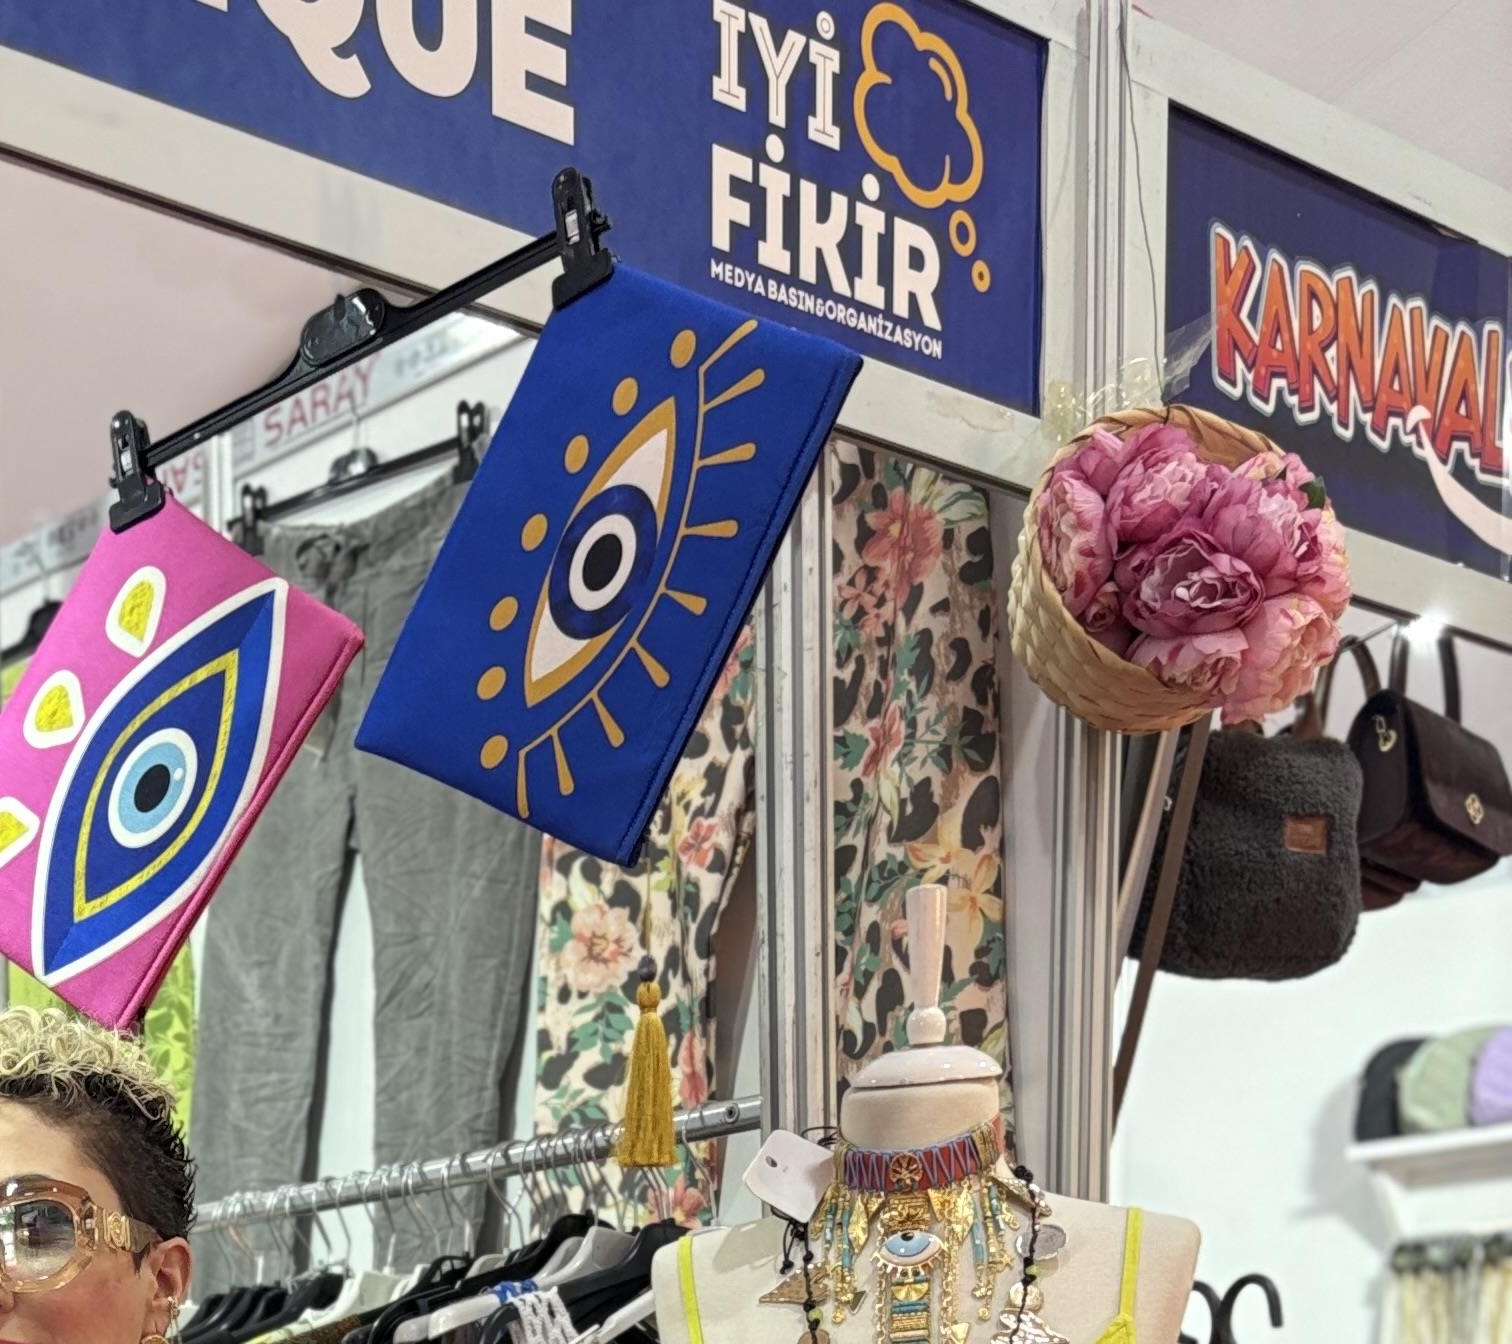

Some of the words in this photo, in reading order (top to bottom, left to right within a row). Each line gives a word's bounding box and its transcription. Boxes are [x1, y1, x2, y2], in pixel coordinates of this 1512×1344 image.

[200, 0, 575, 146] QUE
[710, 257, 766, 297] MEDYA
[712, 133, 942, 331] FİKİR
[1209, 222, 1506, 482] KARNAVAL
